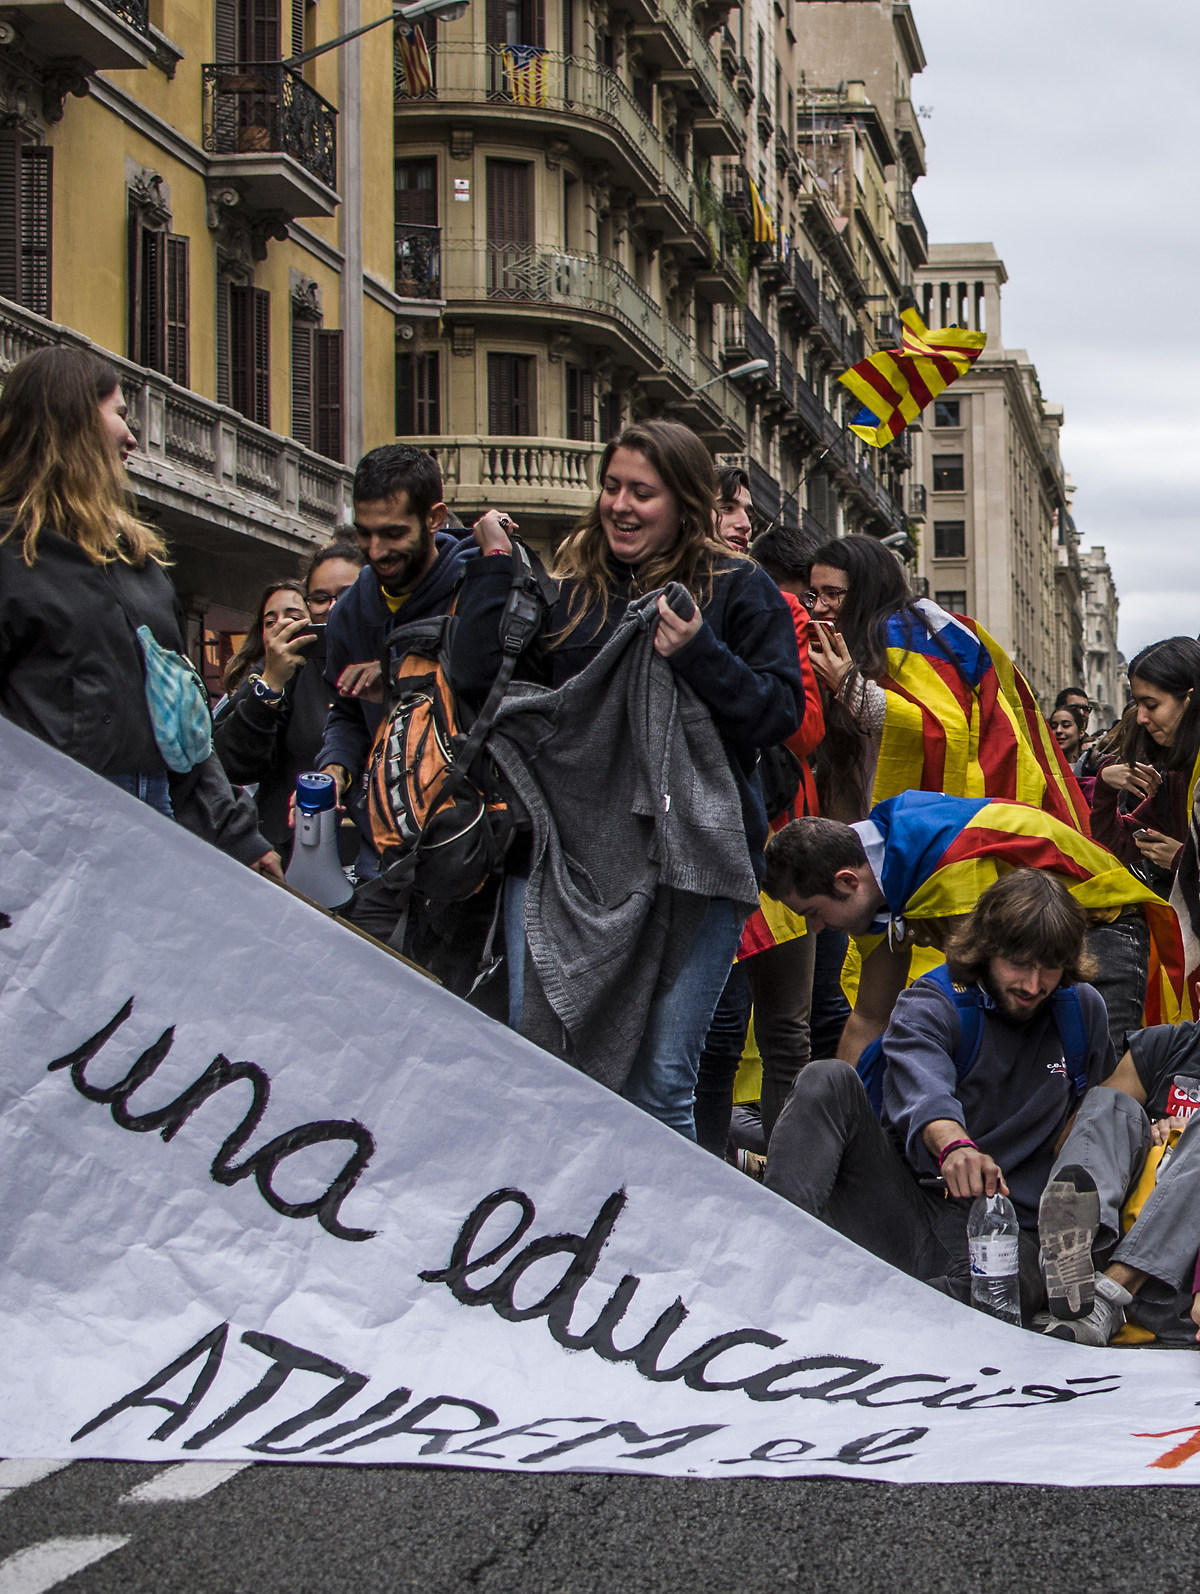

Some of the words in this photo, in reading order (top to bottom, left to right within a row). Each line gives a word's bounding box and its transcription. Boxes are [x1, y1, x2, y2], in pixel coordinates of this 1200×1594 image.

[47, 994, 382, 1242] una
[417, 1181, 1121, 1410] educació
[70, 1319, 733, 1464] ATUREM
[718, 1426, 930, 1465] el
